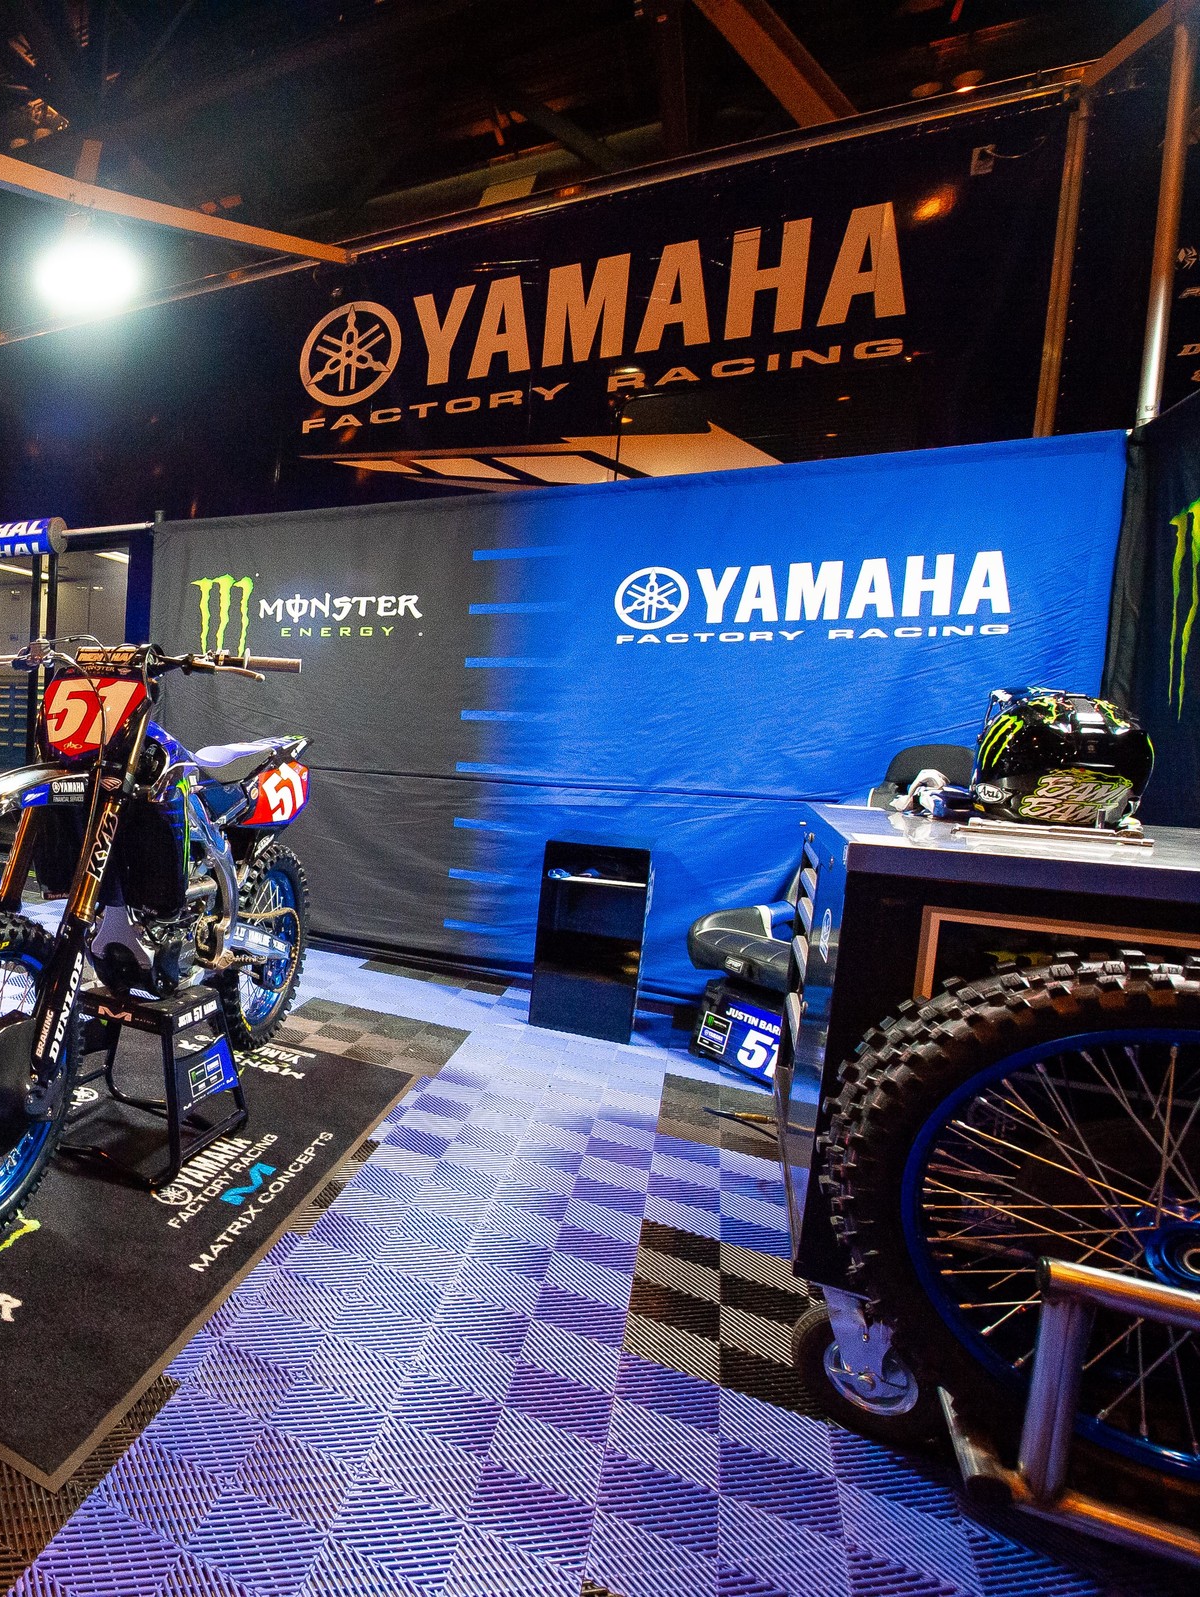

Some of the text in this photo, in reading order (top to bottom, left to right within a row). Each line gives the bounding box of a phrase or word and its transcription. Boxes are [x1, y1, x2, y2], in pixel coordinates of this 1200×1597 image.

[413, 201, 906, 386] YAMAHA
[302, 337, 904, 434] FACTORY RACING
[258, 592, 423, 623] MONSTER
[696, 550, 1011, 624] YAMAHA
[281, 626, 394, 637] ENERGY
[616, 624, 1010, 644] FACTORY RACING
[46, 678, 139, 746] 51
[61, 782, 85, 792] YAMAHA
[262, 762, 305, 822] 51
[35, 1009, 55, 1058] BRAKING
[49, 951, 84, 1064] DUNLOP
[725, 1007, 760, 1027] JUSTIN
[167, 1133, 279, 1229] FACTORY RACING
[179, 1137, 254, 1188] YAMAHA
[189, 1204, 264, 1273] MATRIX
[257, 1131, 334, 1204] CONCEPTS
